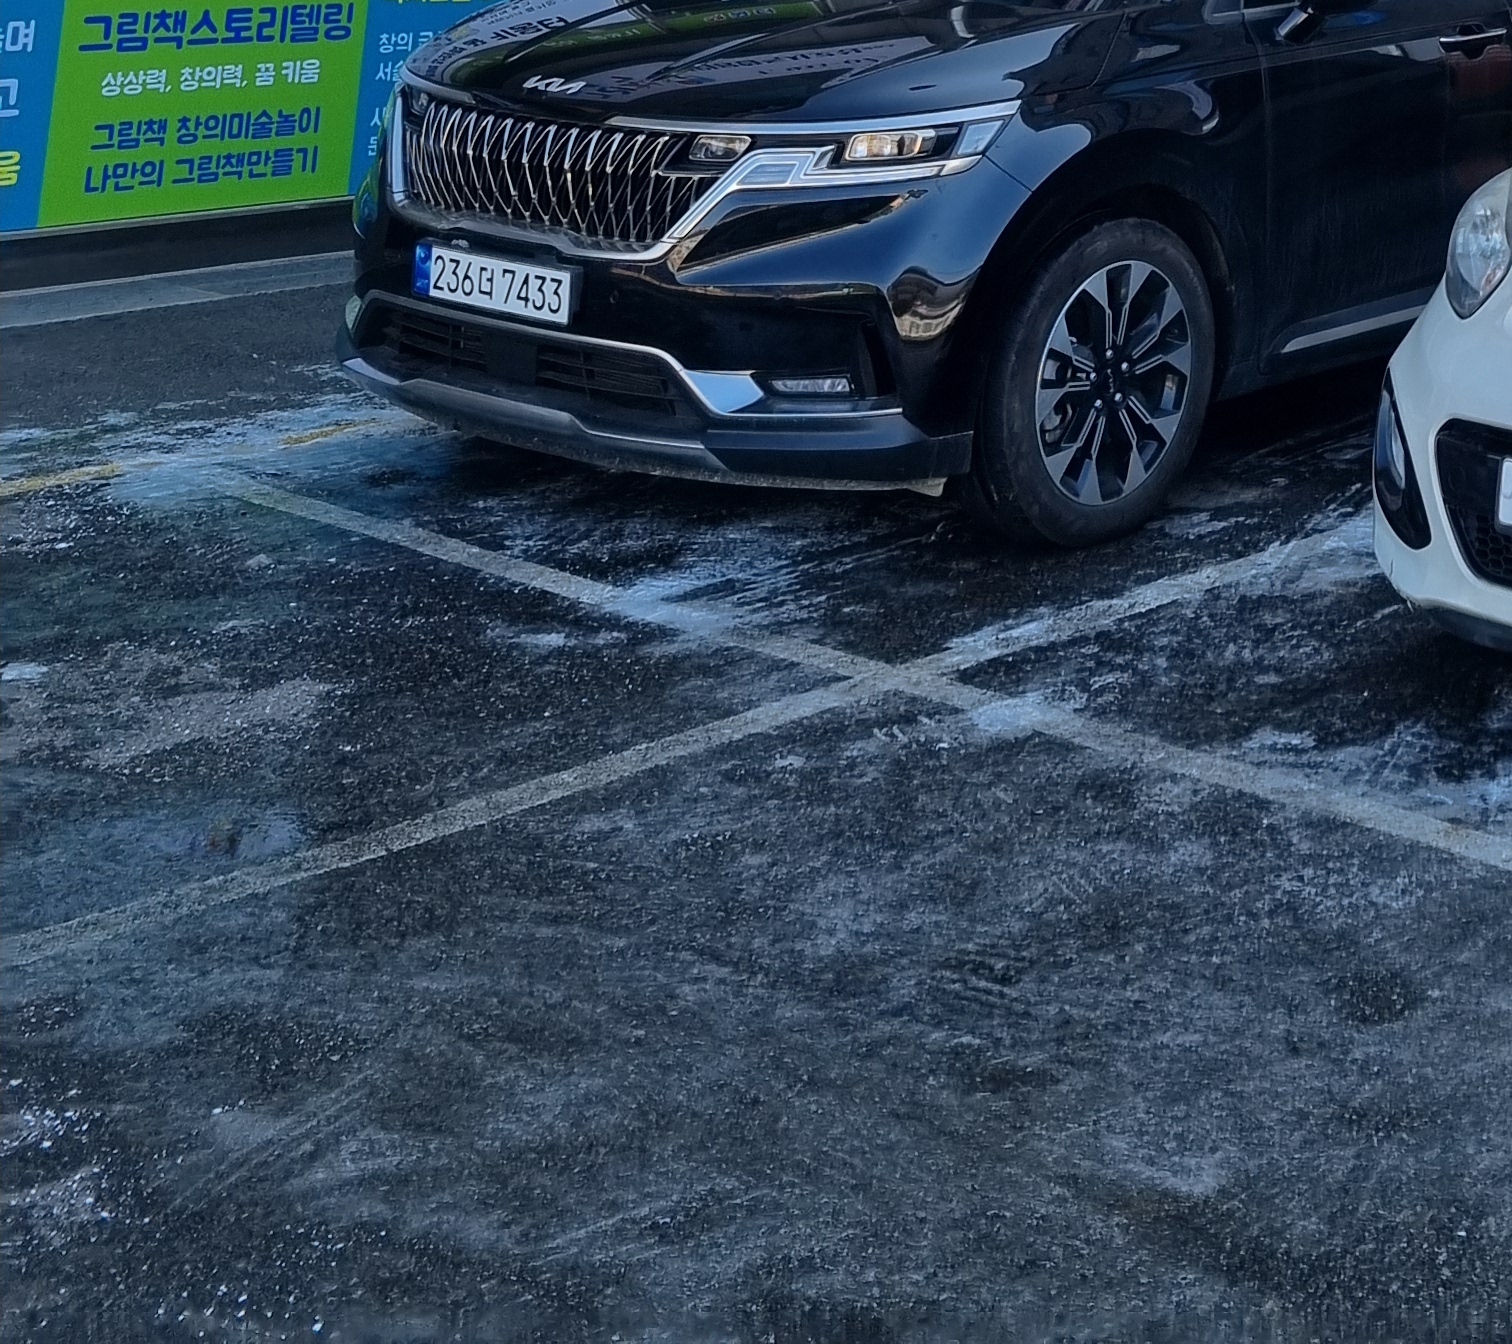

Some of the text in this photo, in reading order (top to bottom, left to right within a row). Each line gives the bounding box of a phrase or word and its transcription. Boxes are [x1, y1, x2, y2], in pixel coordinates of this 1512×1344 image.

[78, 2, 354, 53] 그림책스토리텔링
[101, 59, 320, 97] 상상력, 창의력, 꿈 키움
[90, 106, 321, 151] 그림책 창의미술놀이
[83, 145, 319, 194] 나만의 그림책만들기
[432, 254, 563, 315] 236더 7433
